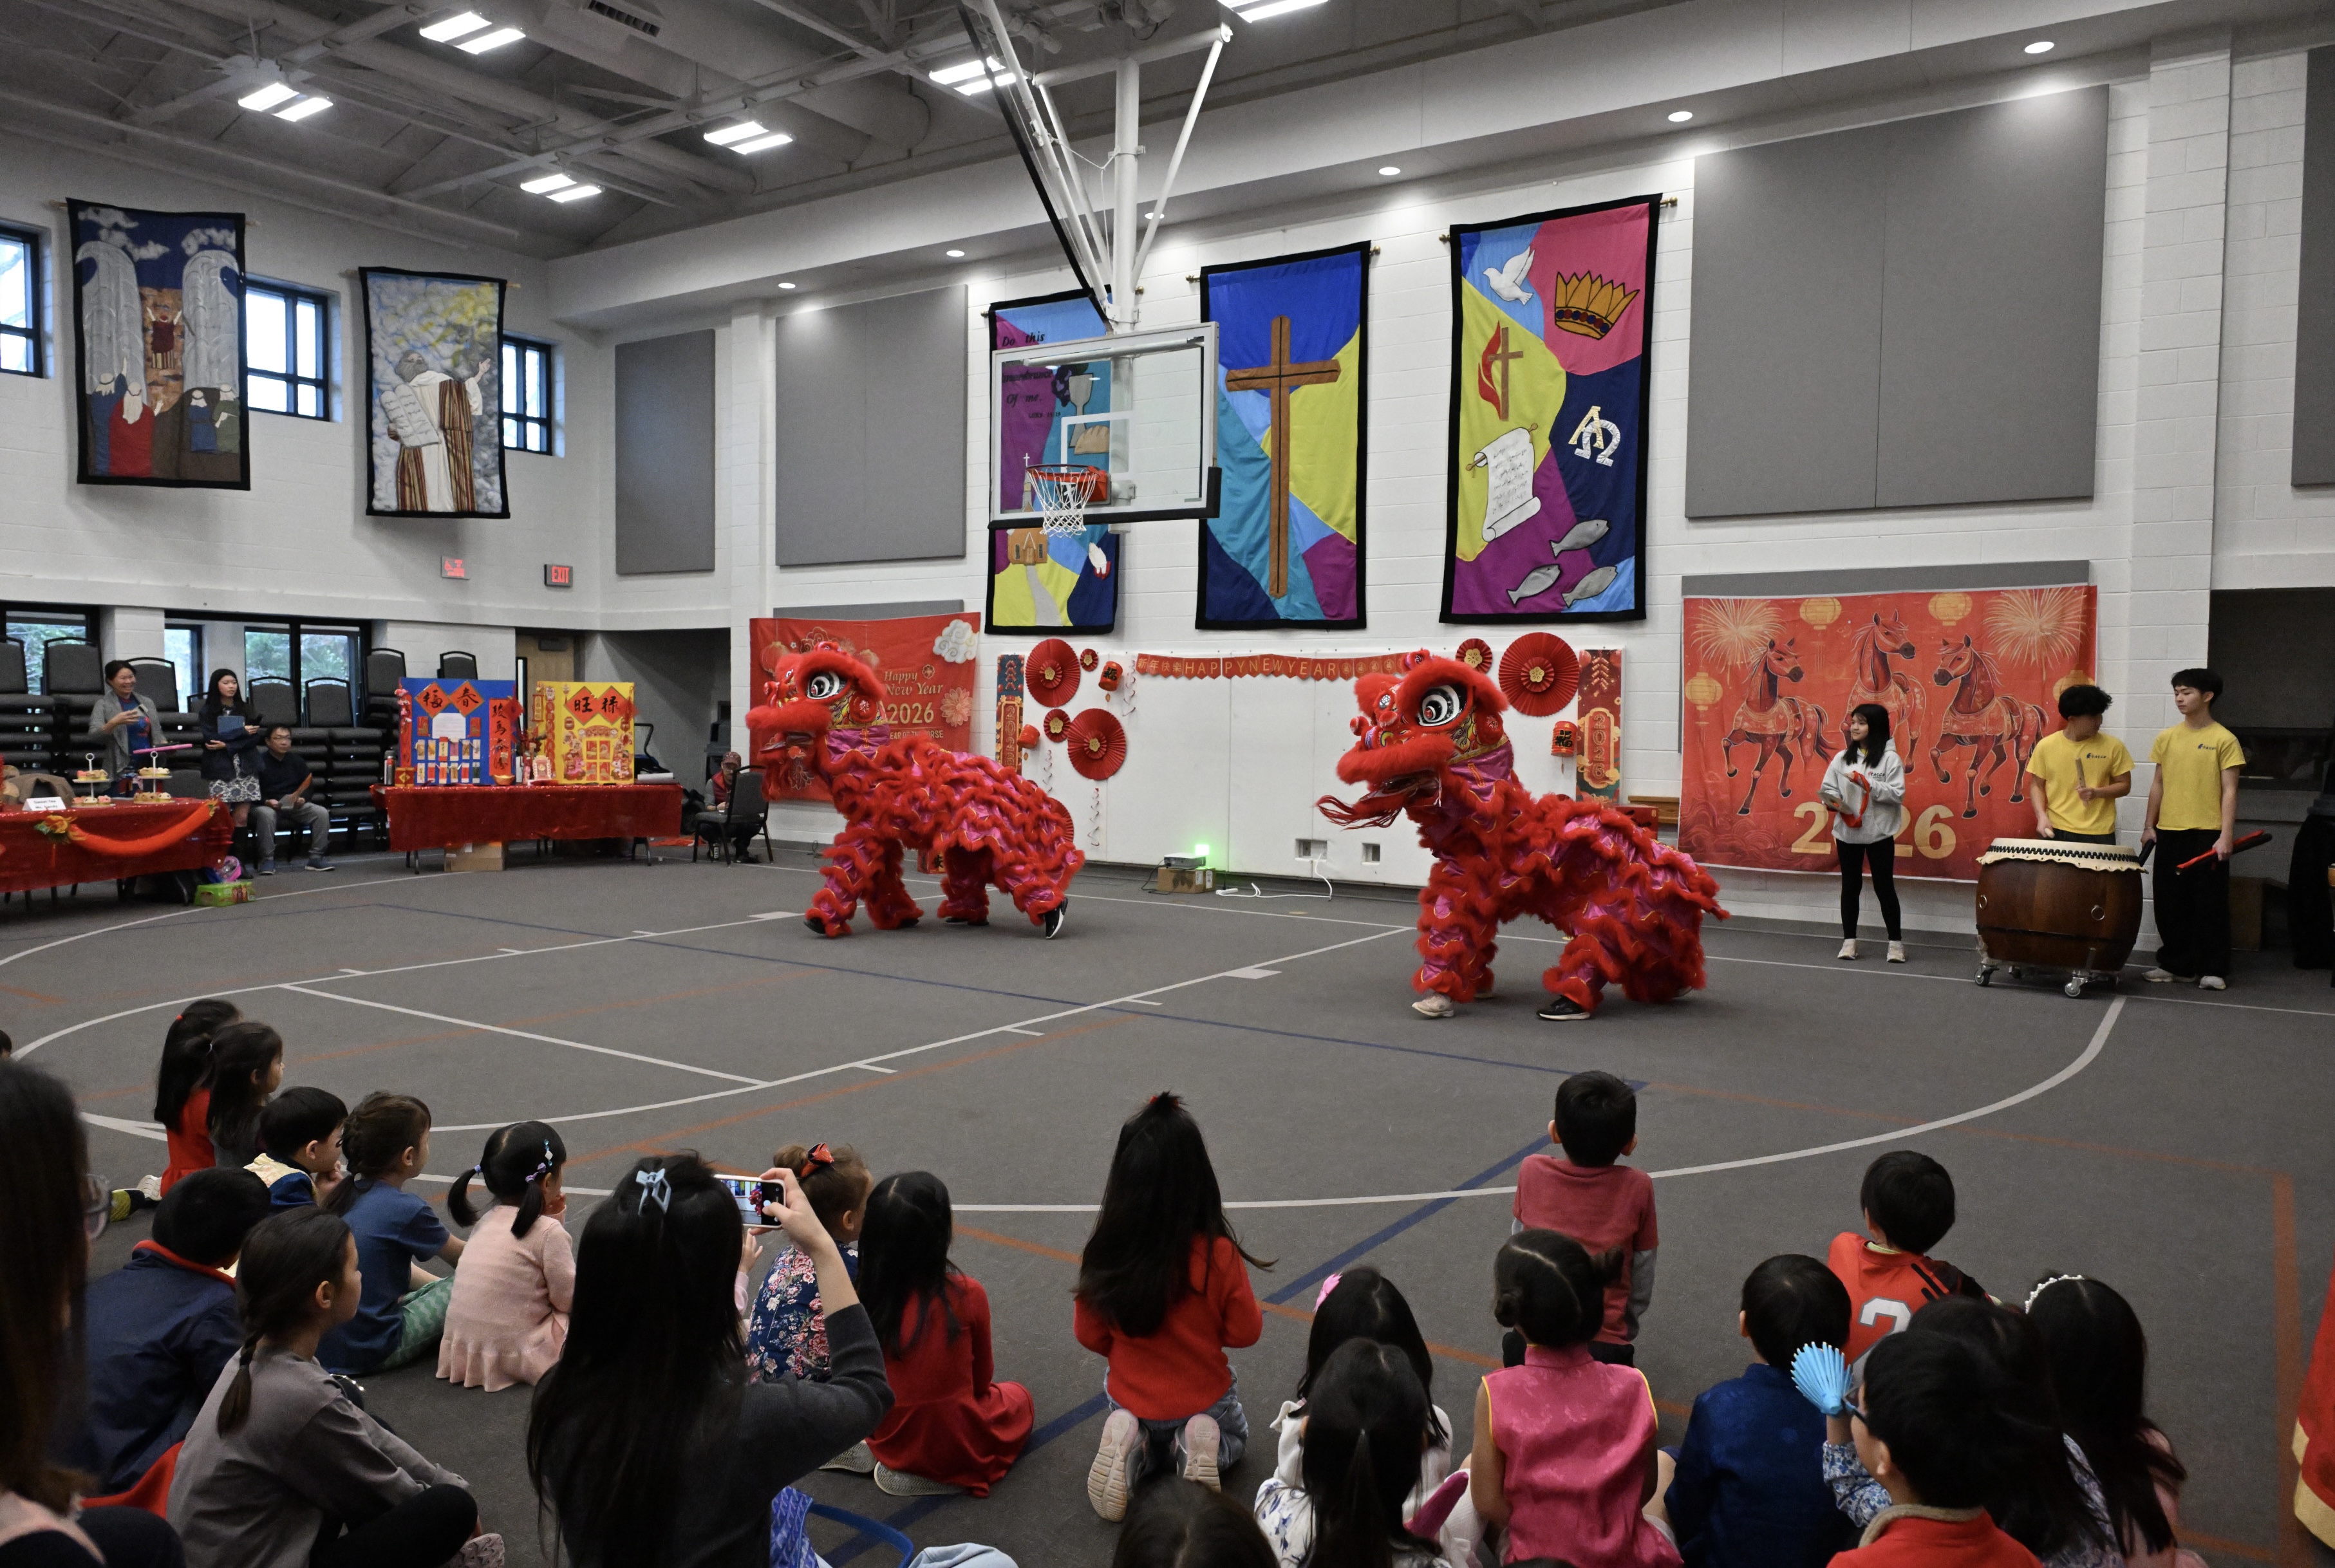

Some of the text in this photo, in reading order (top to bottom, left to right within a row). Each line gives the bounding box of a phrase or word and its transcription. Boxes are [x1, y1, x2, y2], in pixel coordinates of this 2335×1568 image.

[1002, 331, 1046, 347] Do this
[552, 566, 570, 584] EXIT
[1103, 666, 1119, 682] 福
[1137, 658, 1181, 672] 新年快樂
[1185, 661, 1244, 675] HAPPY
[1249, 658, 1283, 672] NEW
[1288, 660, 1336, 677] YEAR
[884, 671, 917, 684] Happy
[457, 687, 479, 707] 春
[886, 682, 943, 695] New Year
[574, 696, 593, 713] 旺
[887, 702, 934, 724] 2026
[890, 731, 901, 740] EAR
[1593, 714, 1606, 779] 2026
[1791, 801, 1956, 859] 226
